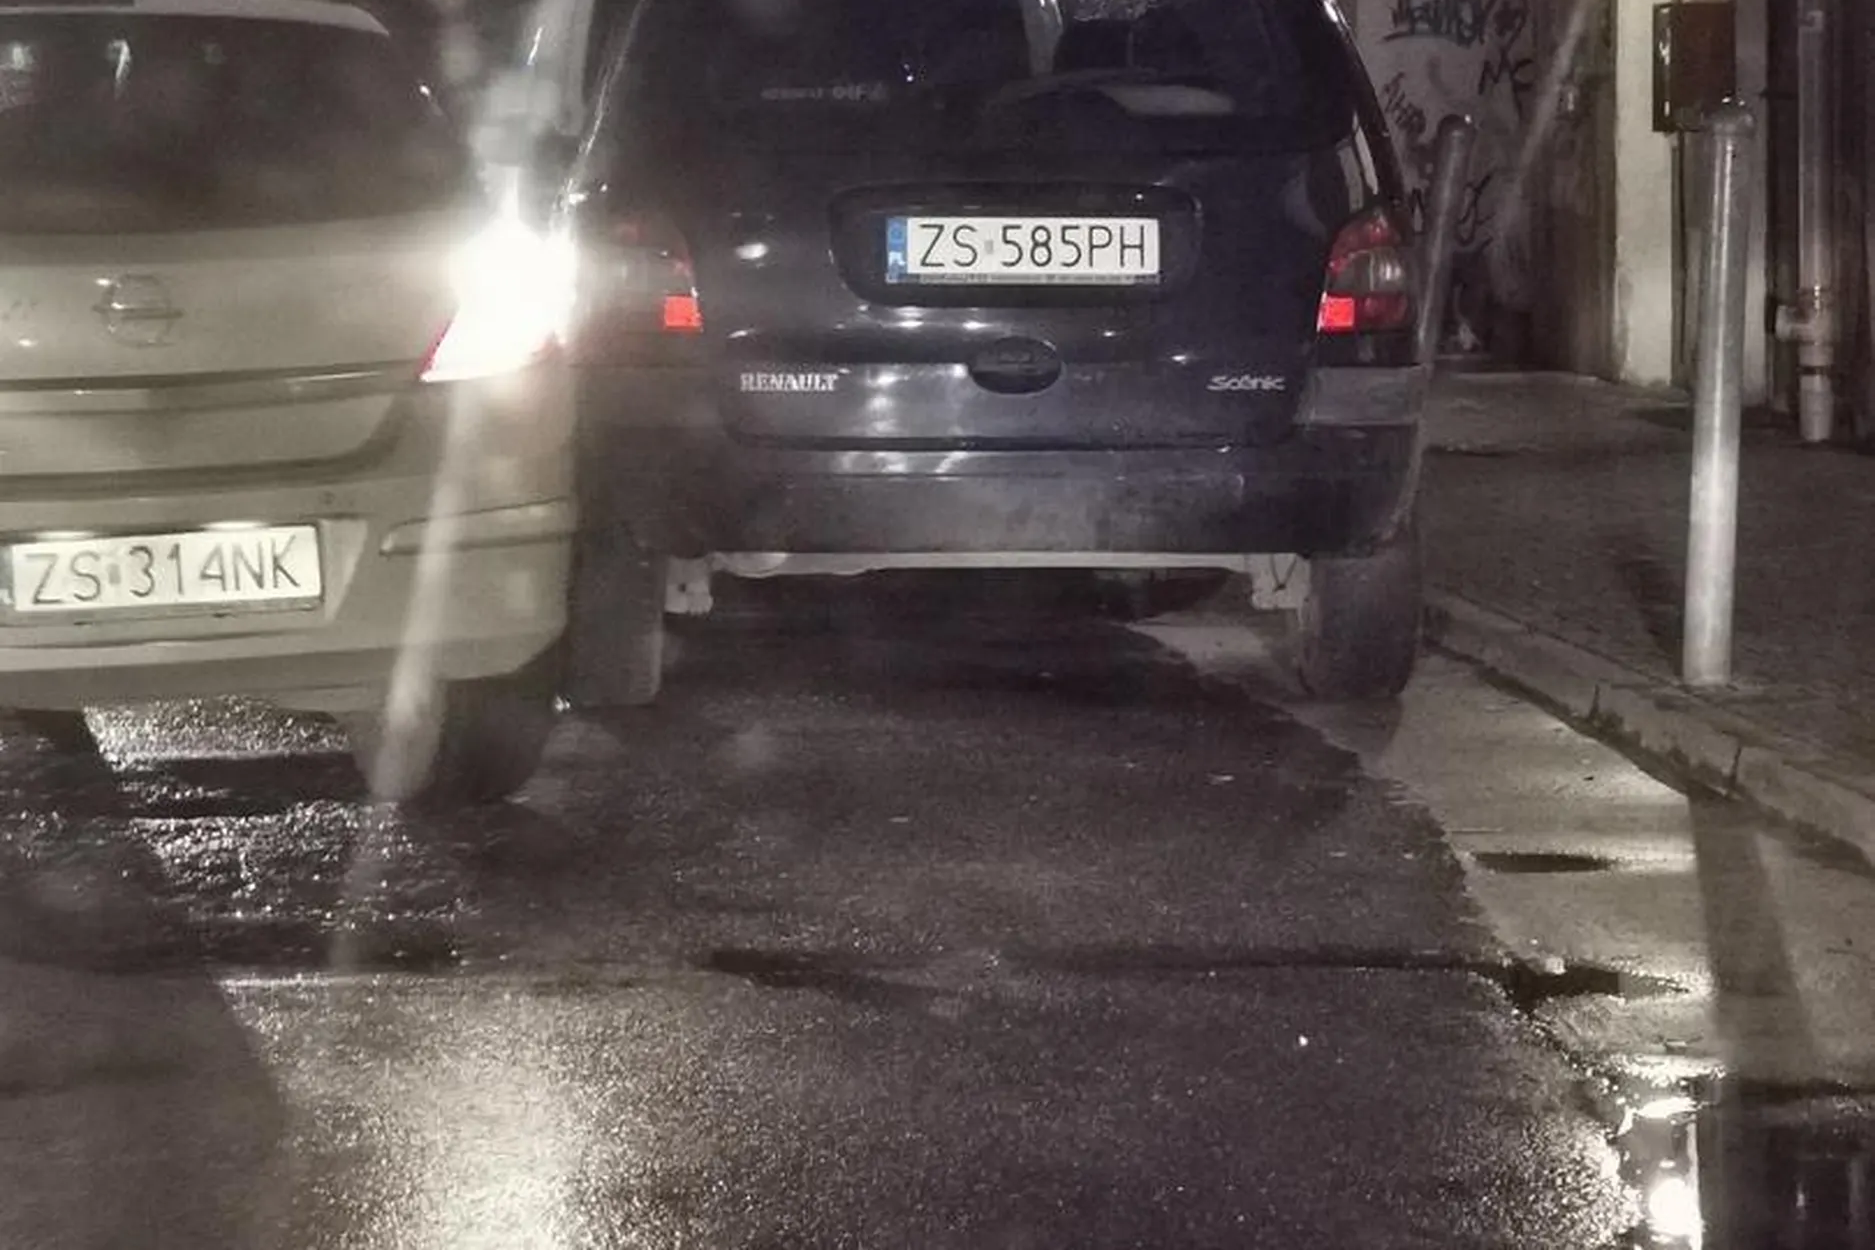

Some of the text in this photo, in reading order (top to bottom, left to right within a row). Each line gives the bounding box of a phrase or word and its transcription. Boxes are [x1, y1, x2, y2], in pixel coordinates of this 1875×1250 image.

[920, 223, 1145, 268] ZS 585PH
[740, 372, 840, 392] RENAULT
[25, 535, 301, 605] ZS 314NK
